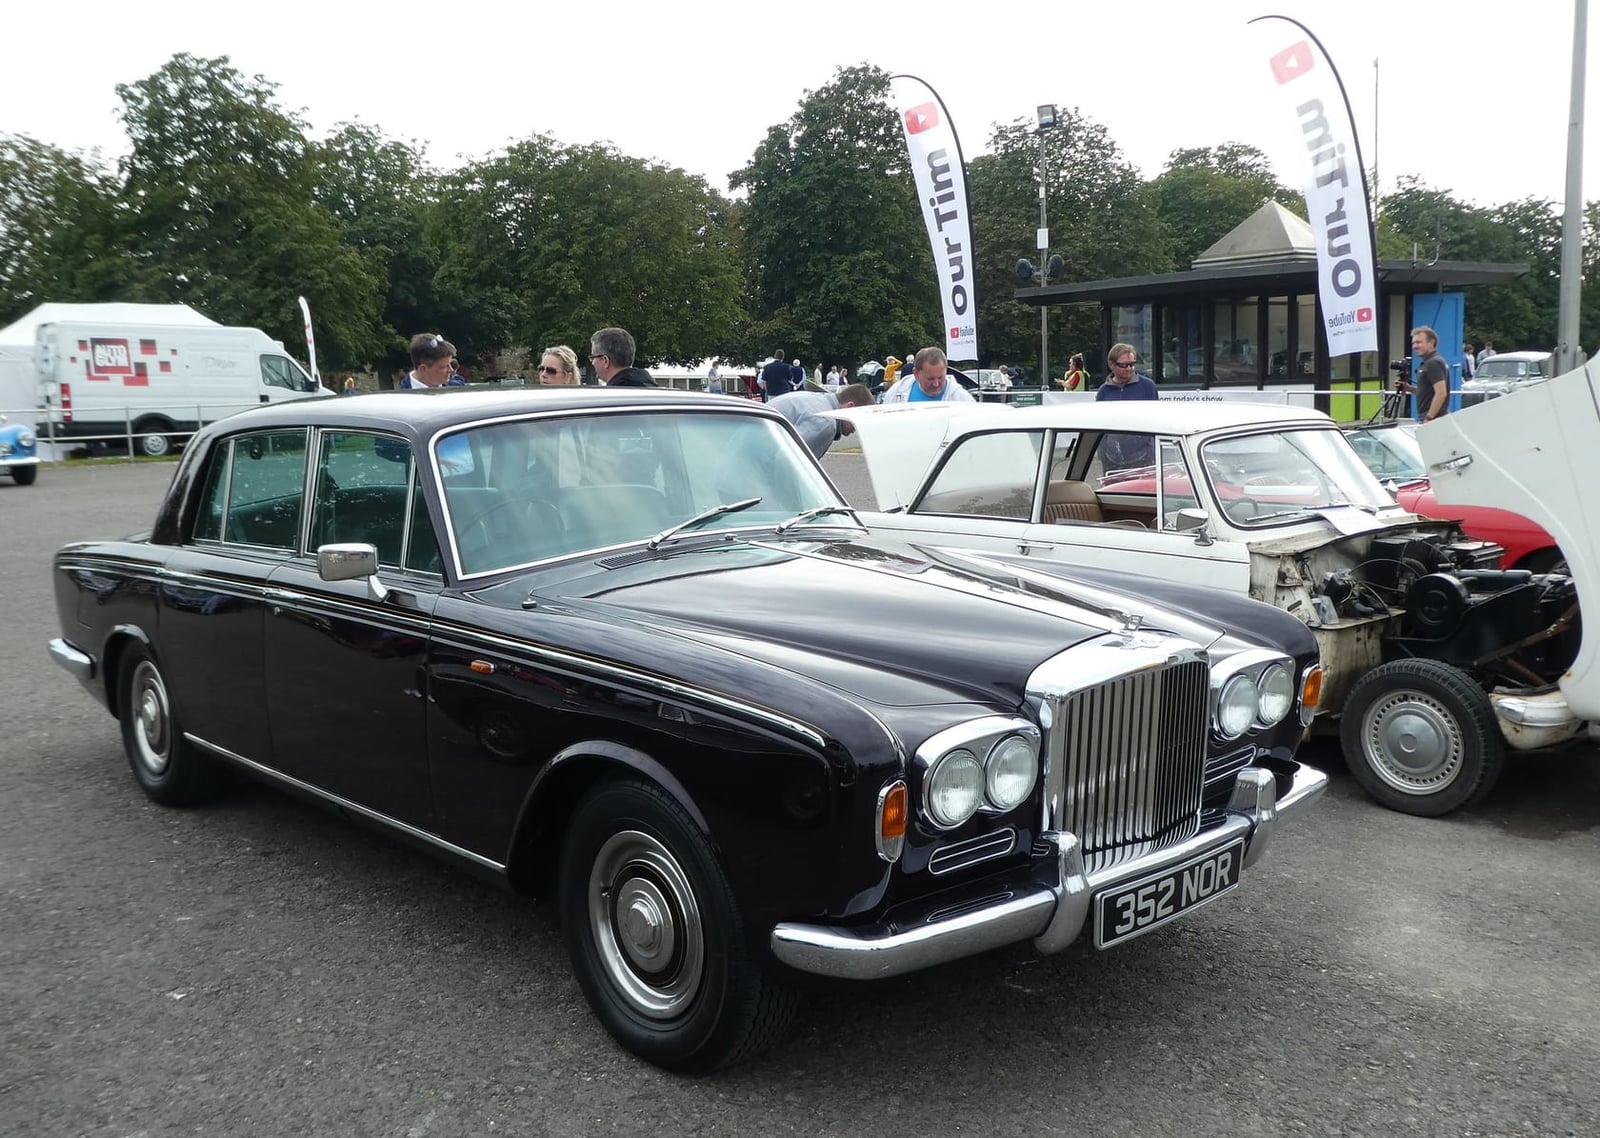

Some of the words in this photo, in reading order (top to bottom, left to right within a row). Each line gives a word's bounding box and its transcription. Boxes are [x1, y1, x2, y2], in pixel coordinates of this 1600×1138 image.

[927, 147, 958, 232] Tim
[945, 237, 968, 316] Our
[1115, 877, 1175, 935] 352
[1181, 851, 1232, 907] NOR
